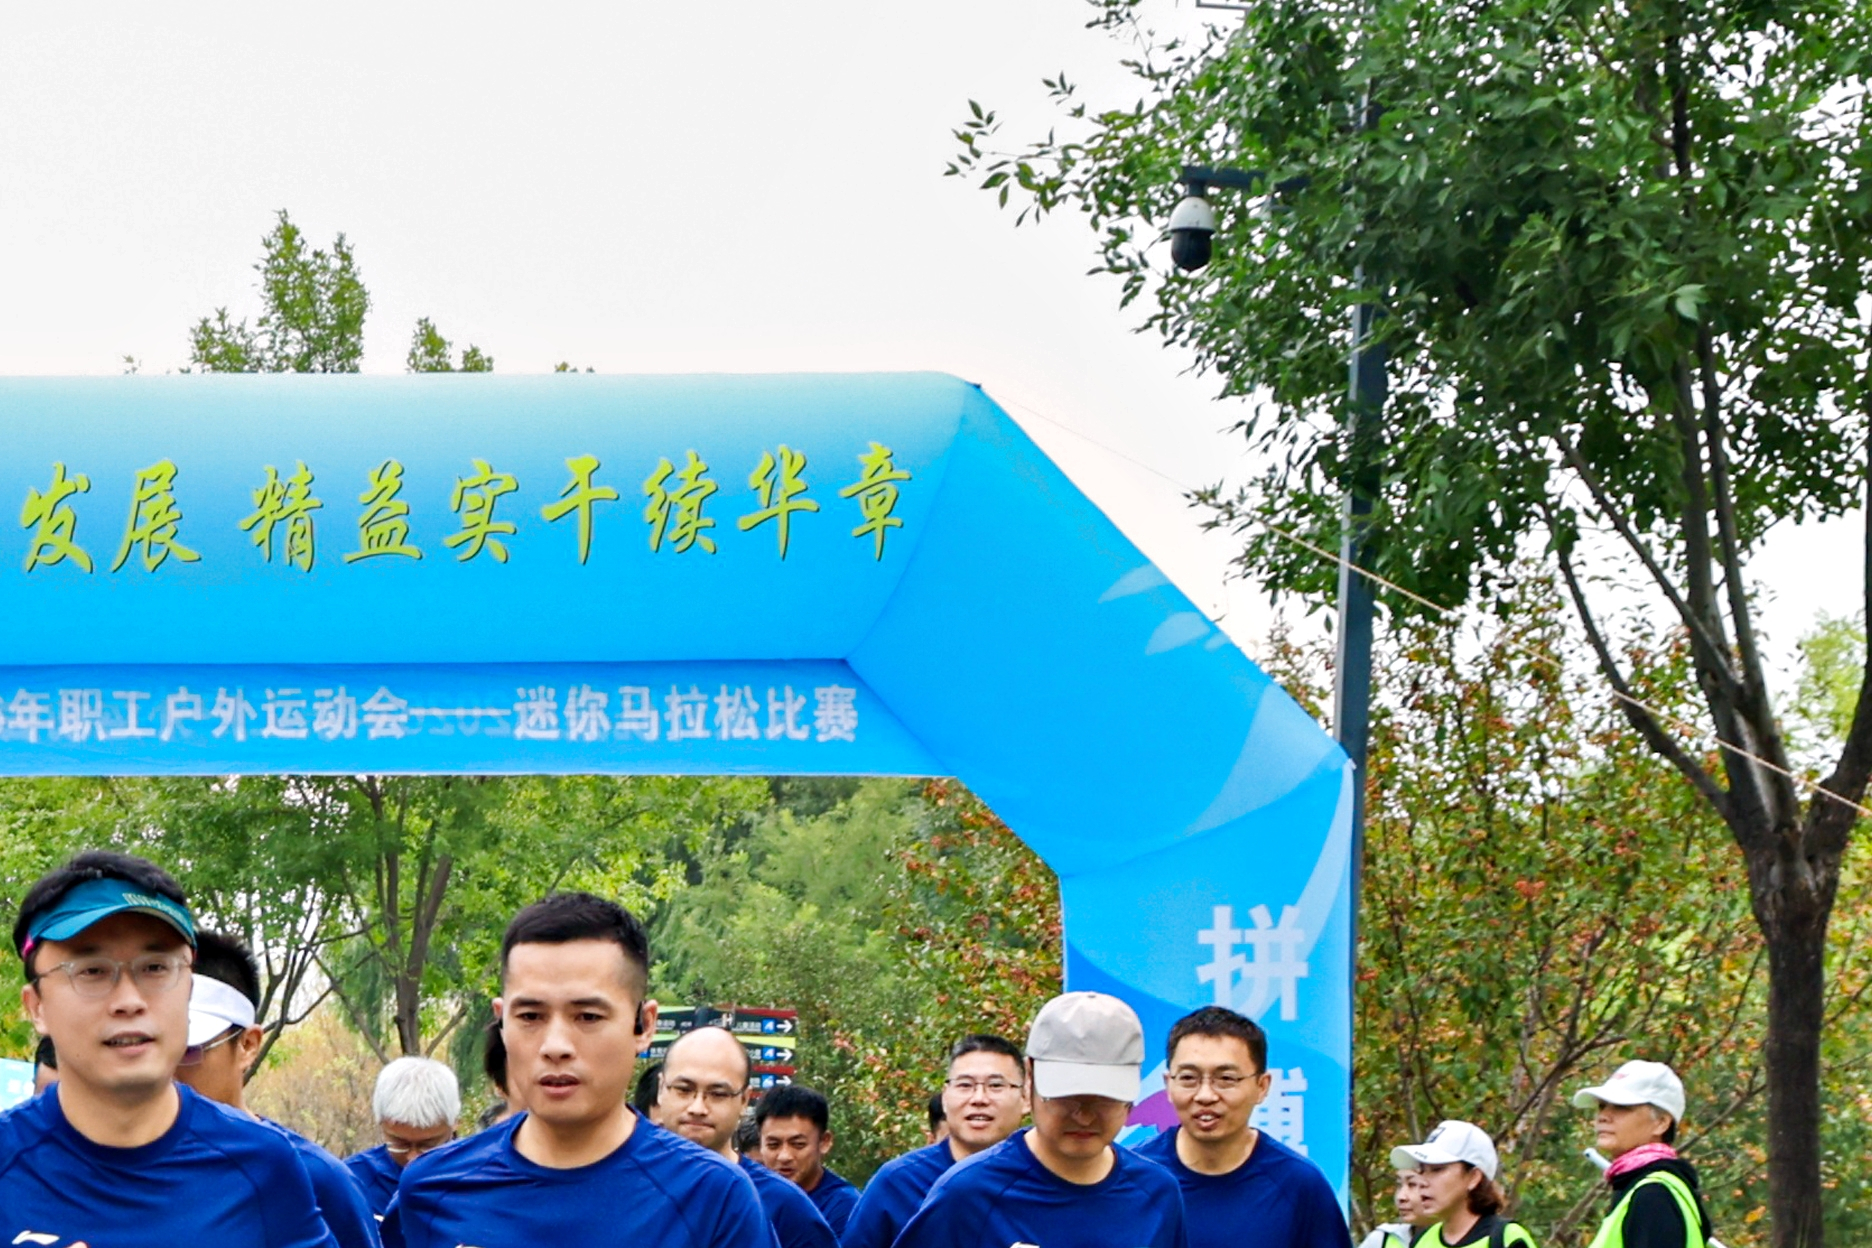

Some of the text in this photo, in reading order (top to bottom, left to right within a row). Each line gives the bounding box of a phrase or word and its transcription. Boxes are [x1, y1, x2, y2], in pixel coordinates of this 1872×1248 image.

[239, 441, 912, 573] 精益实干续华章
